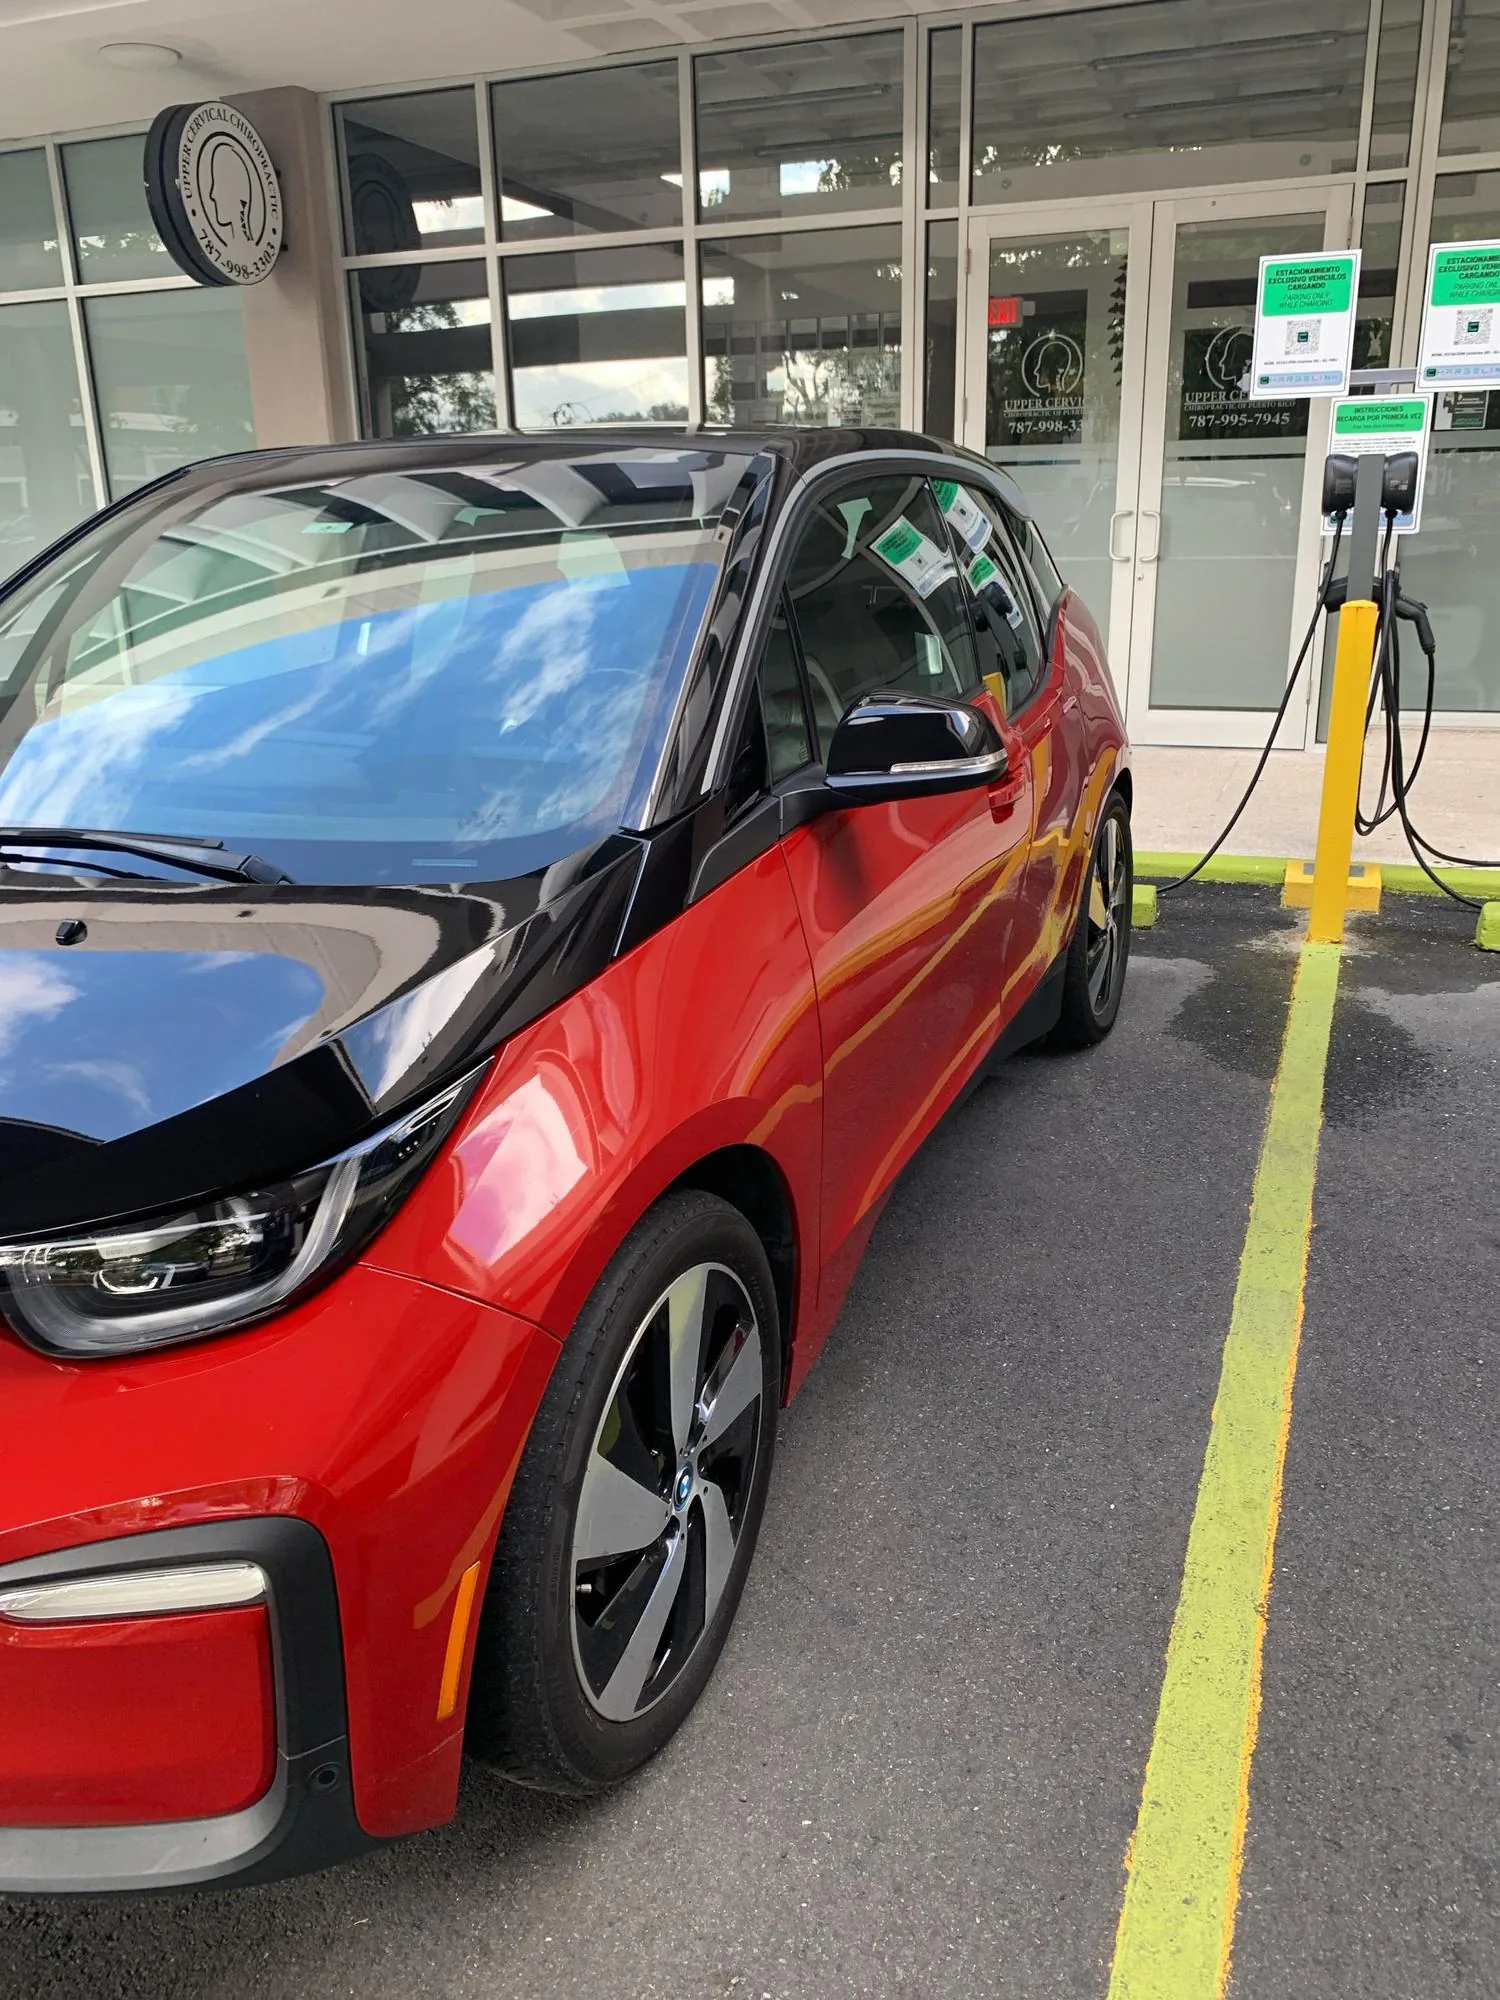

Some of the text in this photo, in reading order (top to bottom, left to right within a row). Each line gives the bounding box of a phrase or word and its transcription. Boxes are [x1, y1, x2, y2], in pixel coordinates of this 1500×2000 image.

[182, 107, 279, 220] UPPER CERVICAL CHIROPRACTIC
[199, 228, 276, 280] 787-998-3303
[1275, 266, 1340, 277] ESTACIONAMIENTO
[1439, 264, 1480, 273] EXCLUSIVO
[1268, 276, 1307, 285] EXCLUSIVO
[1458, 271, 1500, 280] CARGANDO
[1287, 282, 1326, 291] CARGANDO
[1185, 392, 1226, 403] UPPER
[1004, 398, 1043, 410] UPPER
[1354, 405, 1404, 414] INSTRUCCIONES
[1188, 412, 1291, 428] 787-995-7945
[1336, 414, 1366, 422] RECARGA
[1381, 413, 1408, 421] PRIMERA
[1008, 419, 1085, 434] 787-998-33
